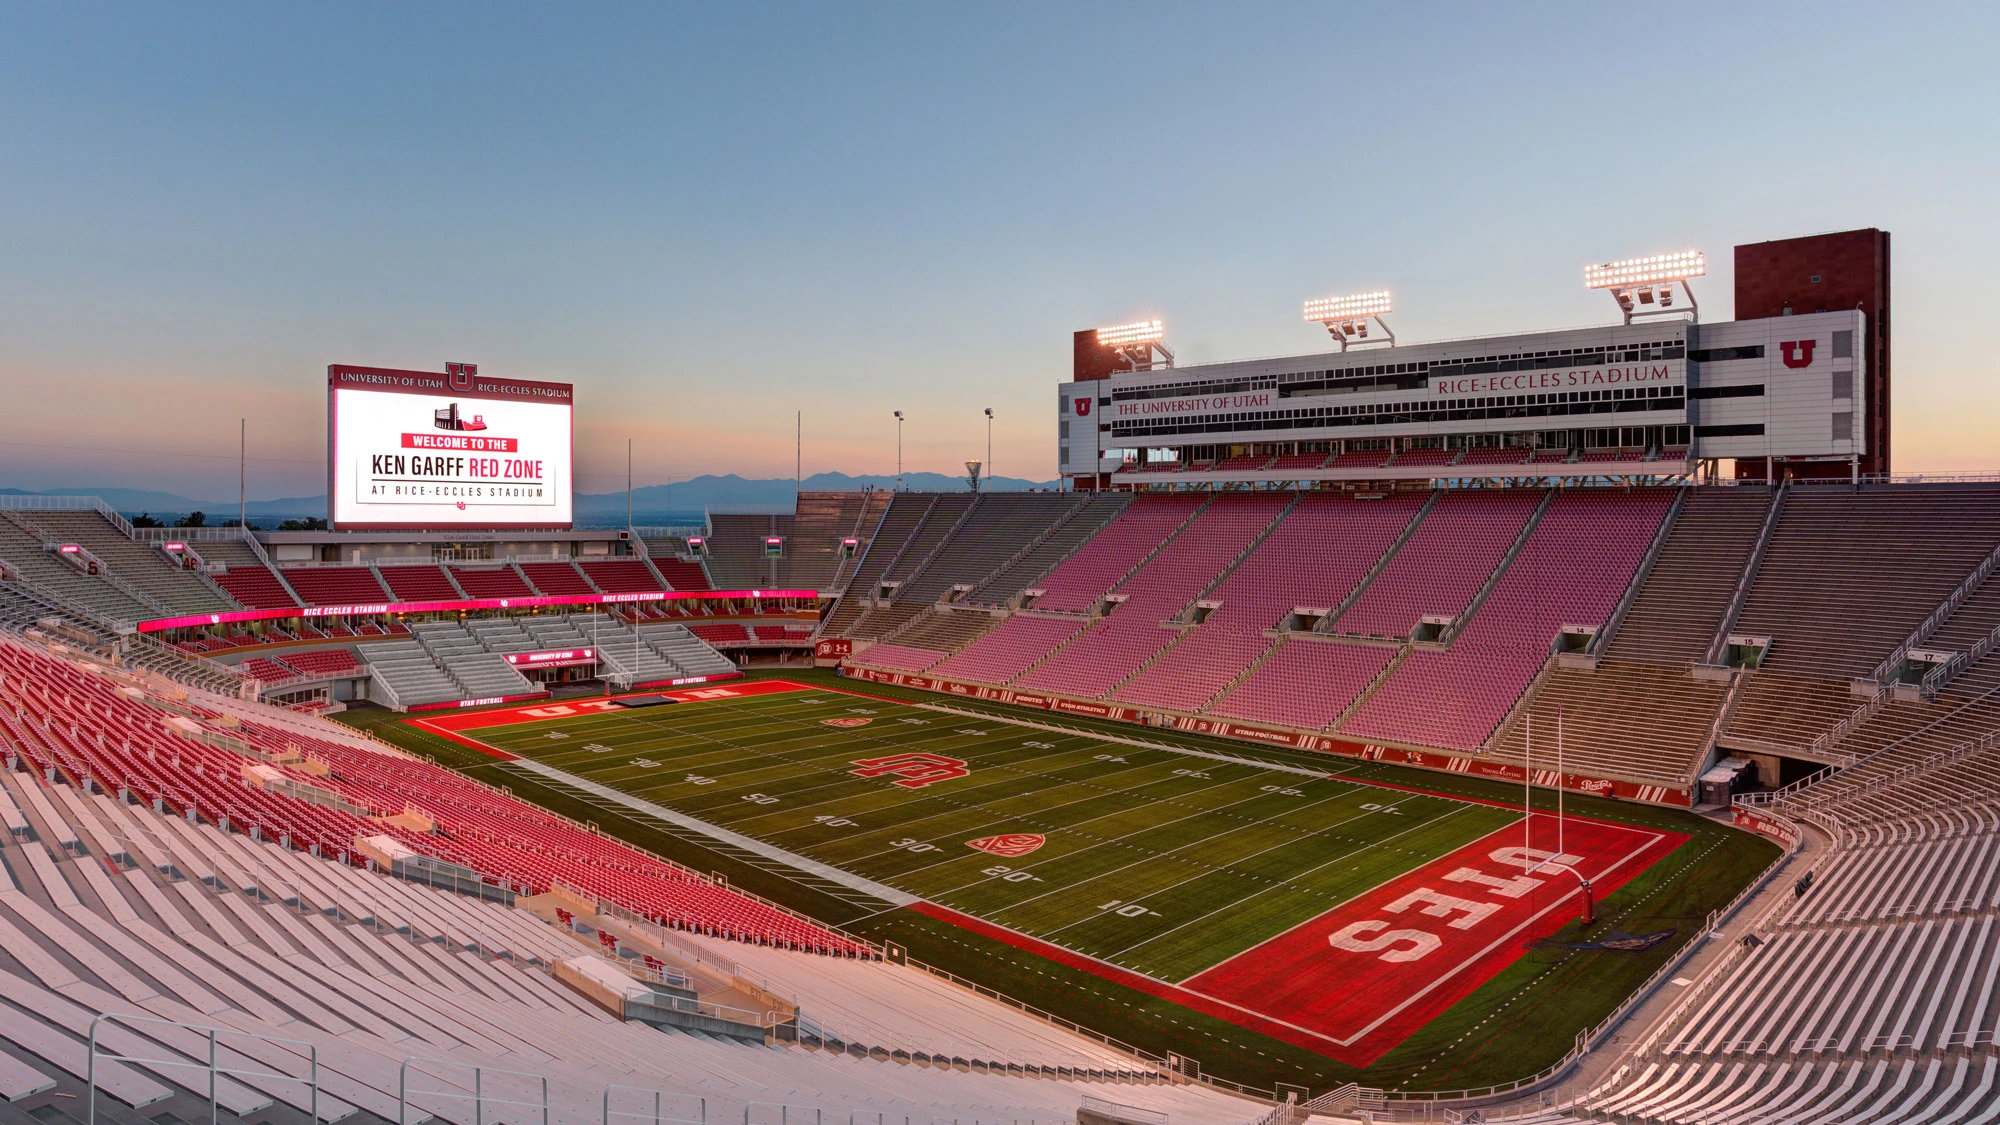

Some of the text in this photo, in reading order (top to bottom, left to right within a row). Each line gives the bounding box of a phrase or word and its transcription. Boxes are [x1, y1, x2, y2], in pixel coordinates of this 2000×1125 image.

[1779, 340, 1816, 368] U
[340, 372, 443, 388] UNIVERSITY OF UTAH
[446, 362, 477, 392] U
[1438, 365, 1669, 394] RICE-ECCLES STADIUM
[478, 383, 570, 398] RICE-ECCLES STADIUM
[1075, 397, 1092, 416] U
[1118, 394, 1269, 415] THE UNIVERSITY OF UTAH
[412, 435, 508, 450] WELCOME TO THE
[372, 454, 543, 479] KEN GARFF RED ZONE
[372, 485, 543, 497] AT RICE-ECCLES STADIUM
[617, 594, 638, 602] ECCLES
[639, 593, 665, 601] STADIUM
[303, 605, 388, 616] RICE ECCLES STADIUM
[529, 653, 555, 661] UNIVERSITY
[684, 676, 707, 684] FOOTBALL
[460, 697, 503, 707] UTAH FOOTBALL
[1076, 704, 1106, 714] ATHLETICS
[1235, 728, 1291, 742] UTAH FOOTBALL
[629, 757, 662, 768] 30
[1481, 767, 1500, 775] YOUNG
[684, 774, 717, 785] 40
[741, 793, 780, 805] 50
[813, 815, 852, 827] 40
[1756, 821, 1780, 836] RED
[889, 838, 936, 853] 30
[980, 865, 1033, 882] 20
[1097, 899, 1141, 918] 10
